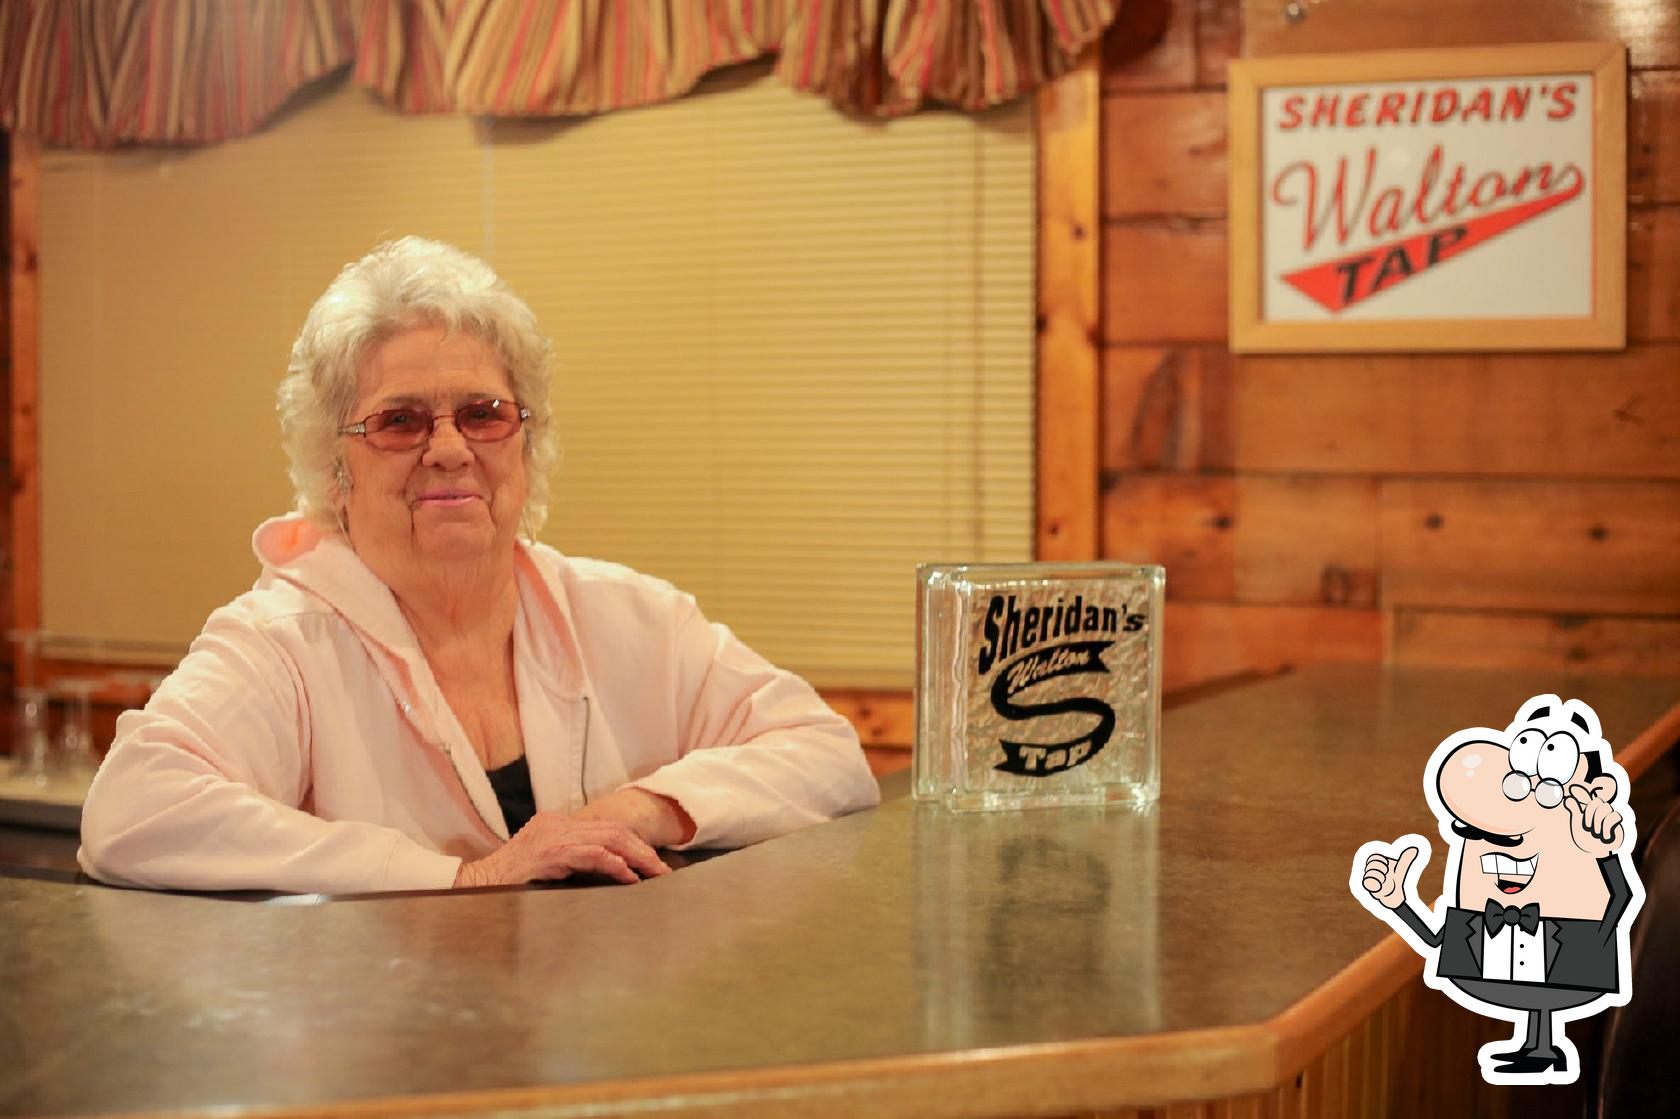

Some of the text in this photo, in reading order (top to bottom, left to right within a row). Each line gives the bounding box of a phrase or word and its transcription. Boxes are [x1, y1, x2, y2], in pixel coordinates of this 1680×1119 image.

[1277, 81, 1579, 132] SHERIDAN'S
[1271, 143, 1586, 251] Walton
[1335, 226, 1468, 304] TAP
[978, 594, 1145, 675] Sheridan's
[1006, 648, 1090, 693] Walton
